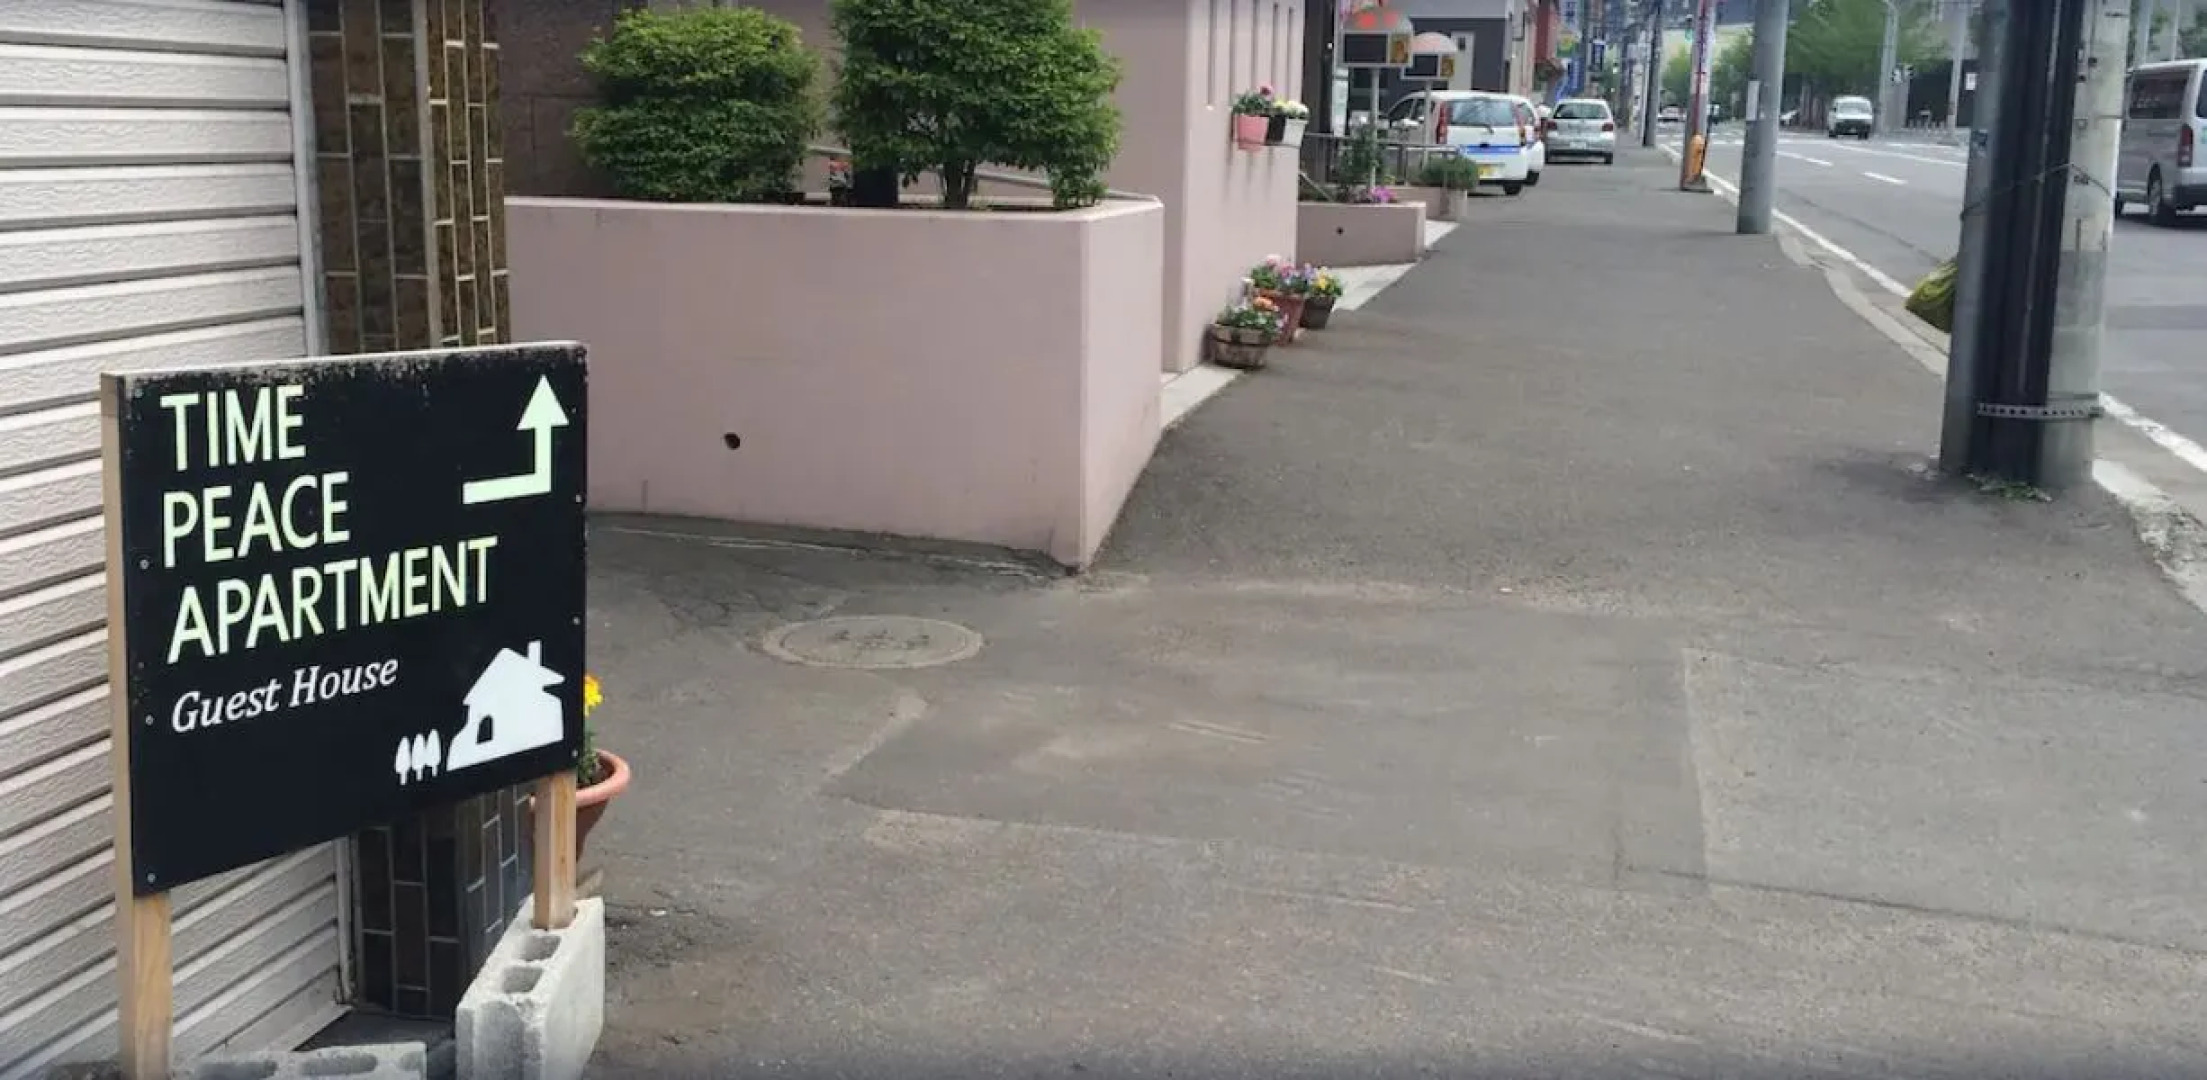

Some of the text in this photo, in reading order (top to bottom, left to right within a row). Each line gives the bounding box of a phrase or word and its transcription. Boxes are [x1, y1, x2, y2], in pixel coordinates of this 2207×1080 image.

[161, 384, 306, 471] TIME
[163, 471, 350, 568] PEACE
[167, 536, 498, 664] APARTMENT
[172, 658, 398, 733] Guest House
